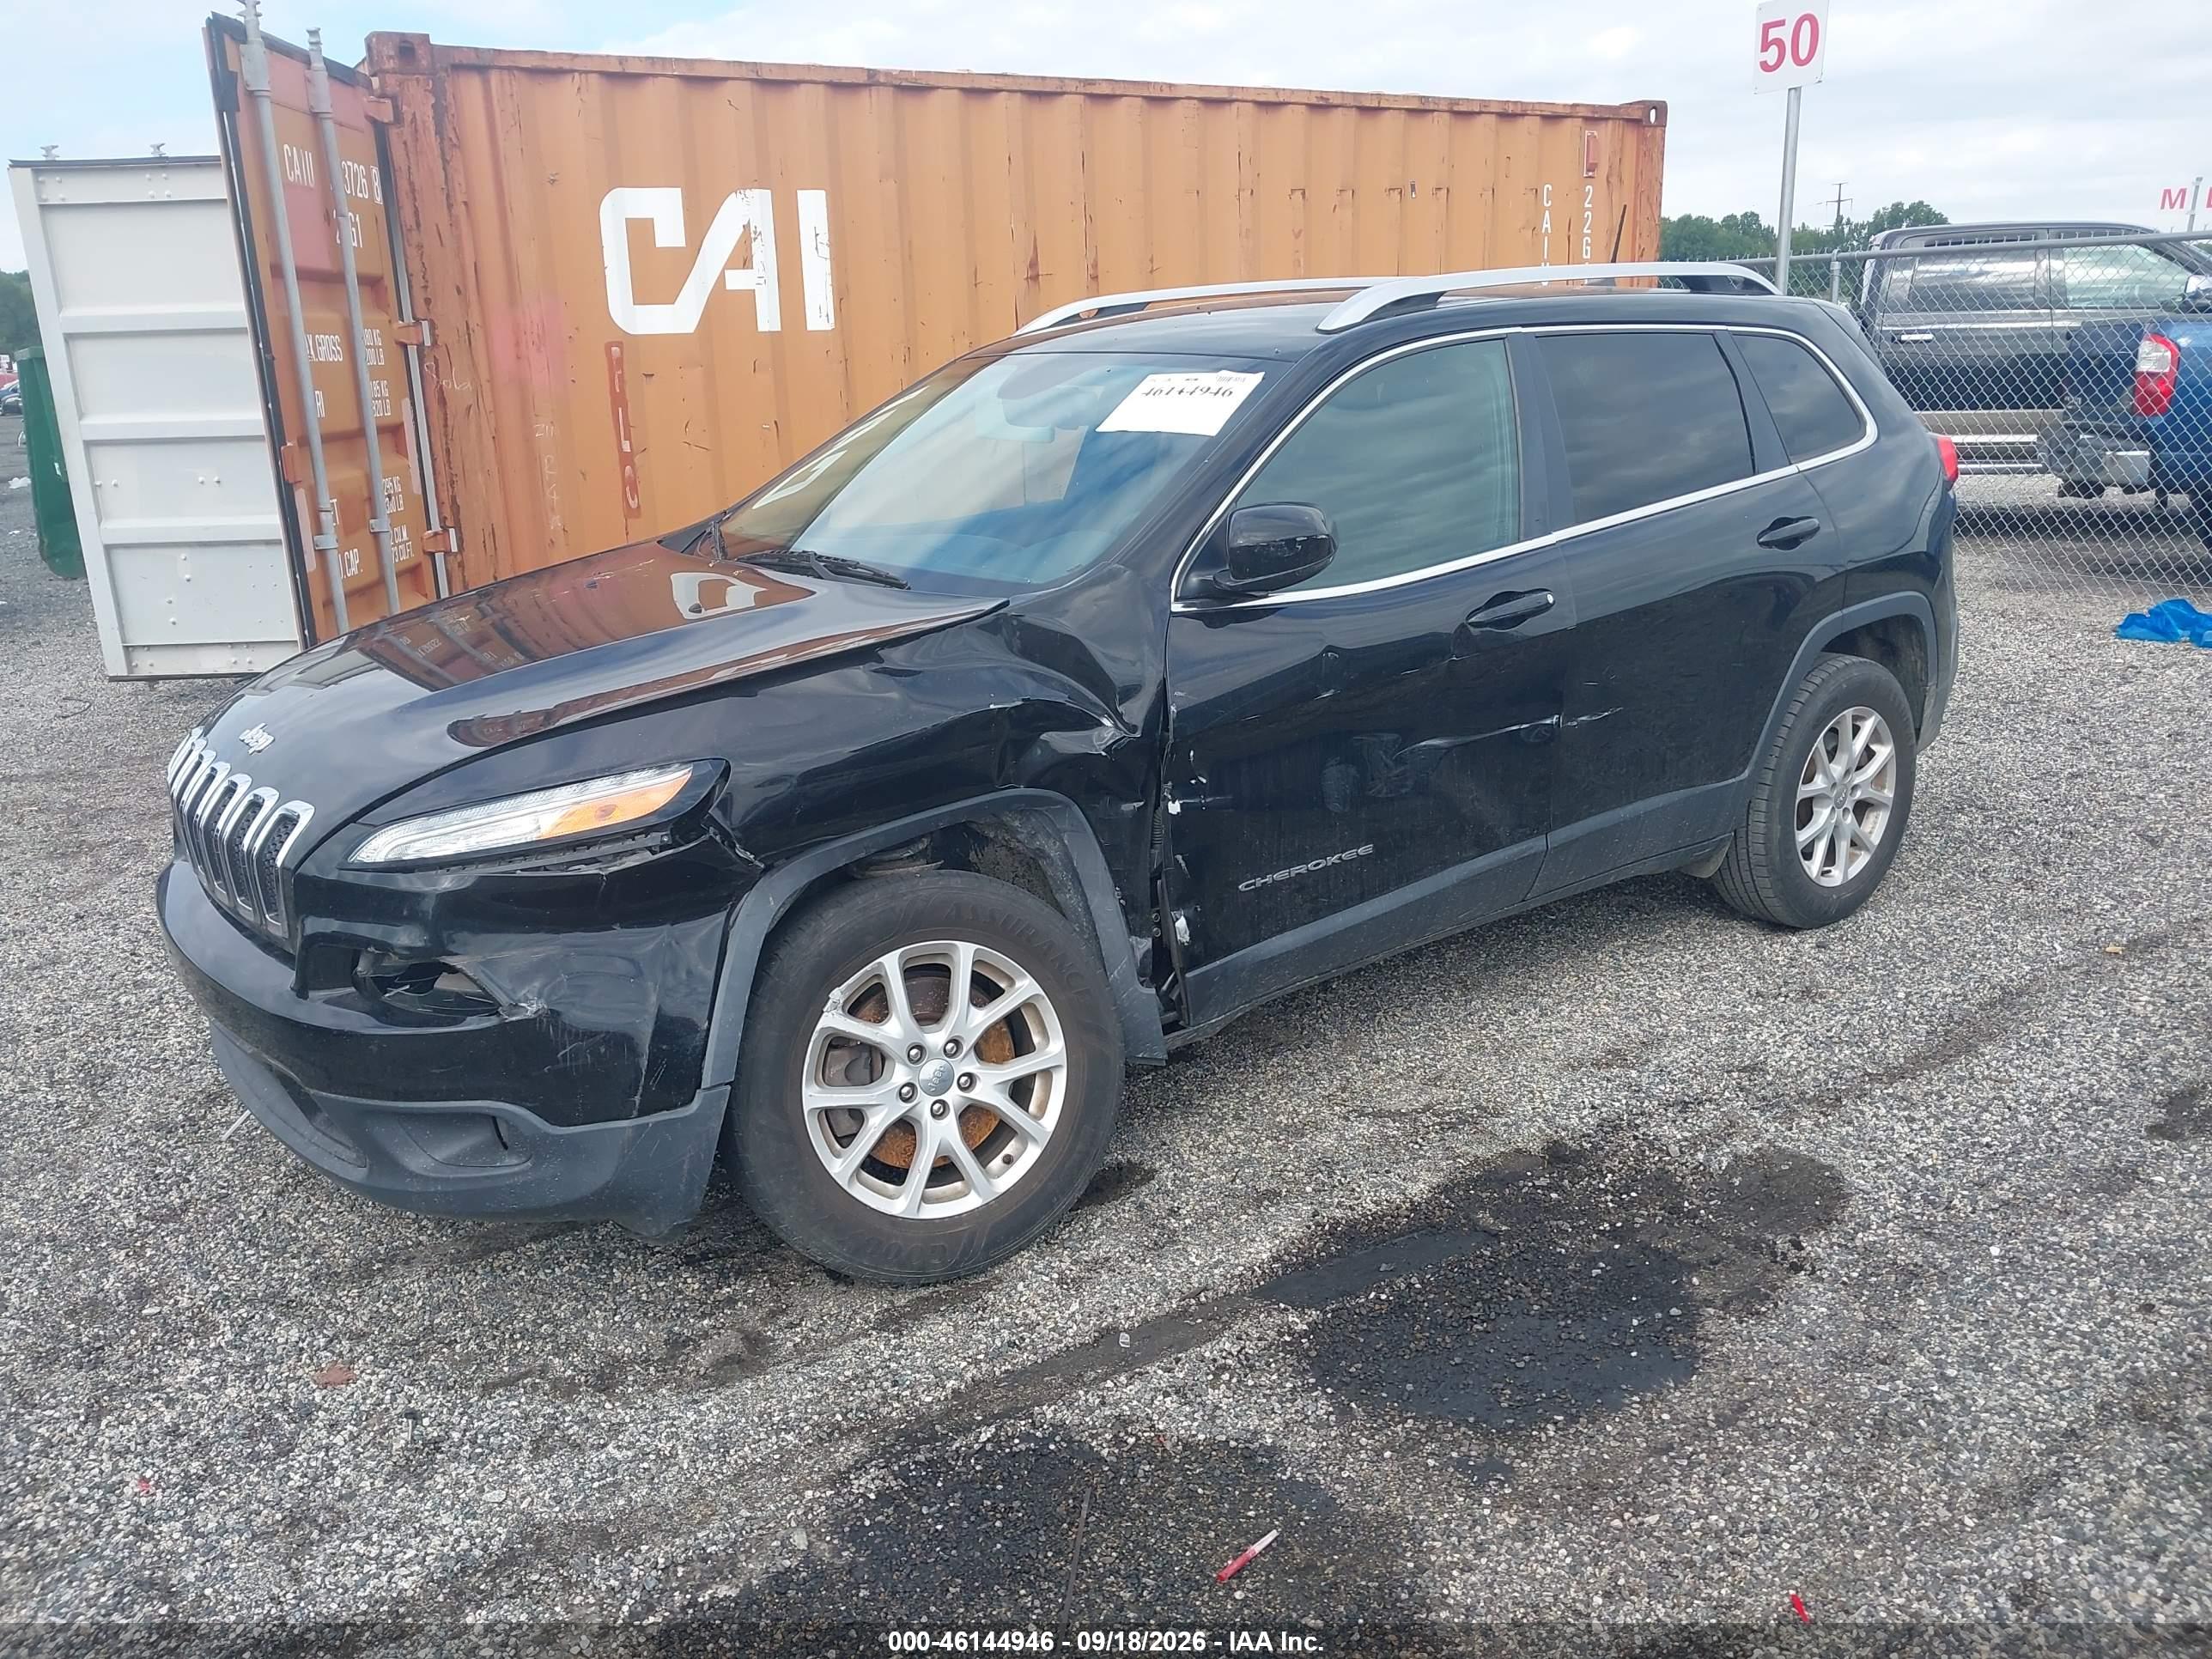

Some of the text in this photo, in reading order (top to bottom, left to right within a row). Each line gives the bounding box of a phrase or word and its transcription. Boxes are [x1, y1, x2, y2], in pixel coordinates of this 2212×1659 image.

[1759, 13, 1820, 72] 50
[283, 143, 314, 187] CAIU
[330, 161, 368, 198] 3726
[599, 187, 835, 335] CAI
[1583, 185, 1593, 284] 22G
[370, 380, 380, 398] 185
[1238, 844, 1374, 891] CHEROKEE
